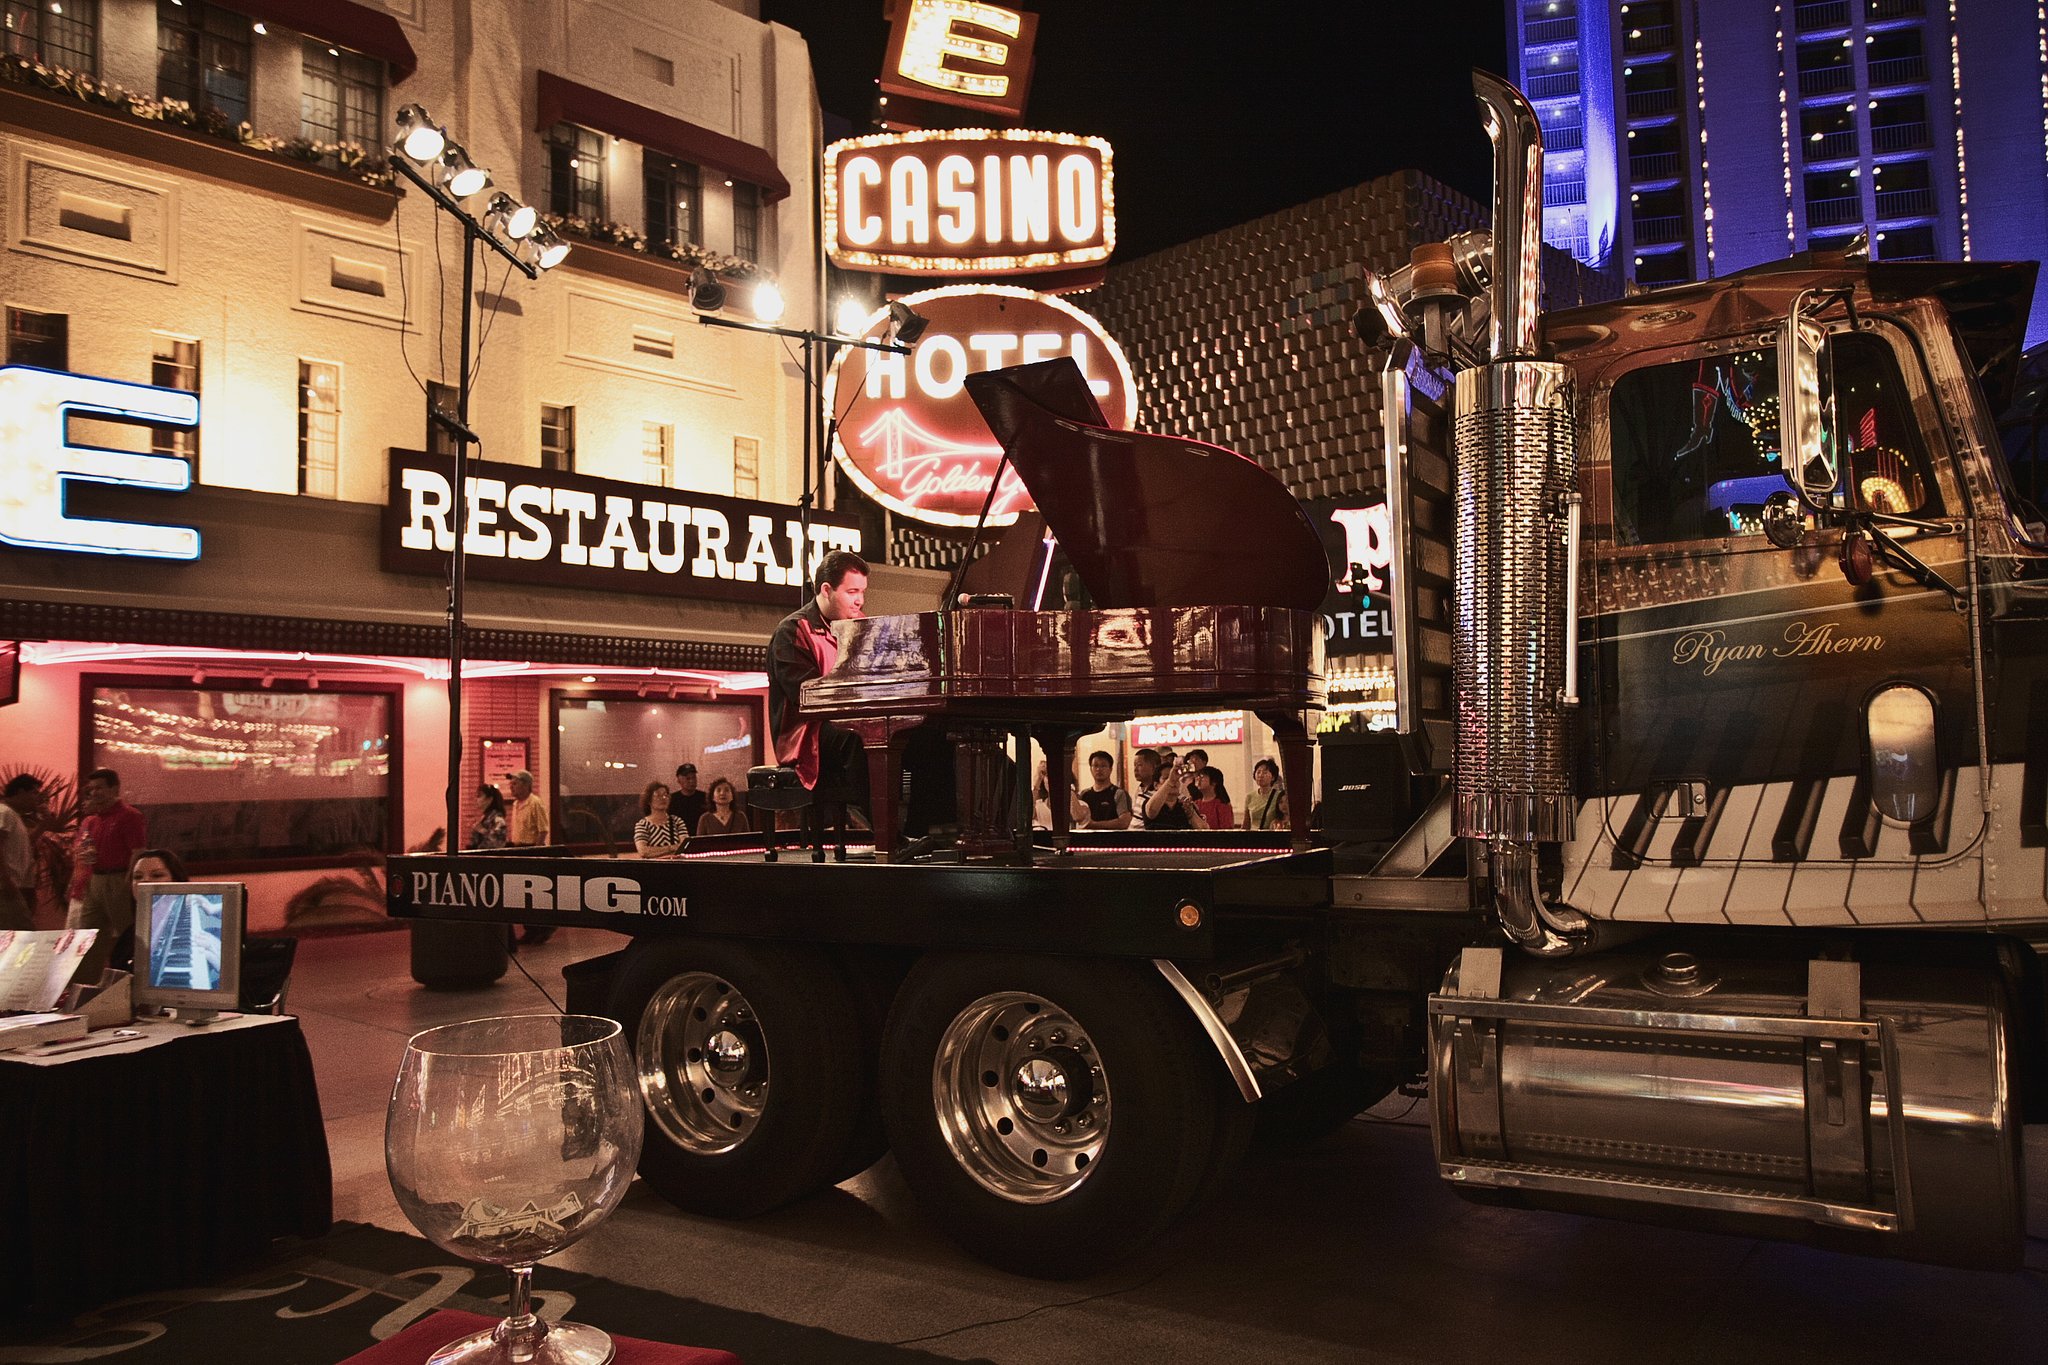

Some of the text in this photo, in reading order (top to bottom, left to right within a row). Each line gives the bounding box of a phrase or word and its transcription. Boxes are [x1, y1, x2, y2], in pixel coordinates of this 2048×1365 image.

[843, 154, 1097, 246] CASINO
[900, 457, 993, 505] Golden
[1330, 503, 1391, 594] P
[1672, 621, 1885, 676] Ryan Ahern
